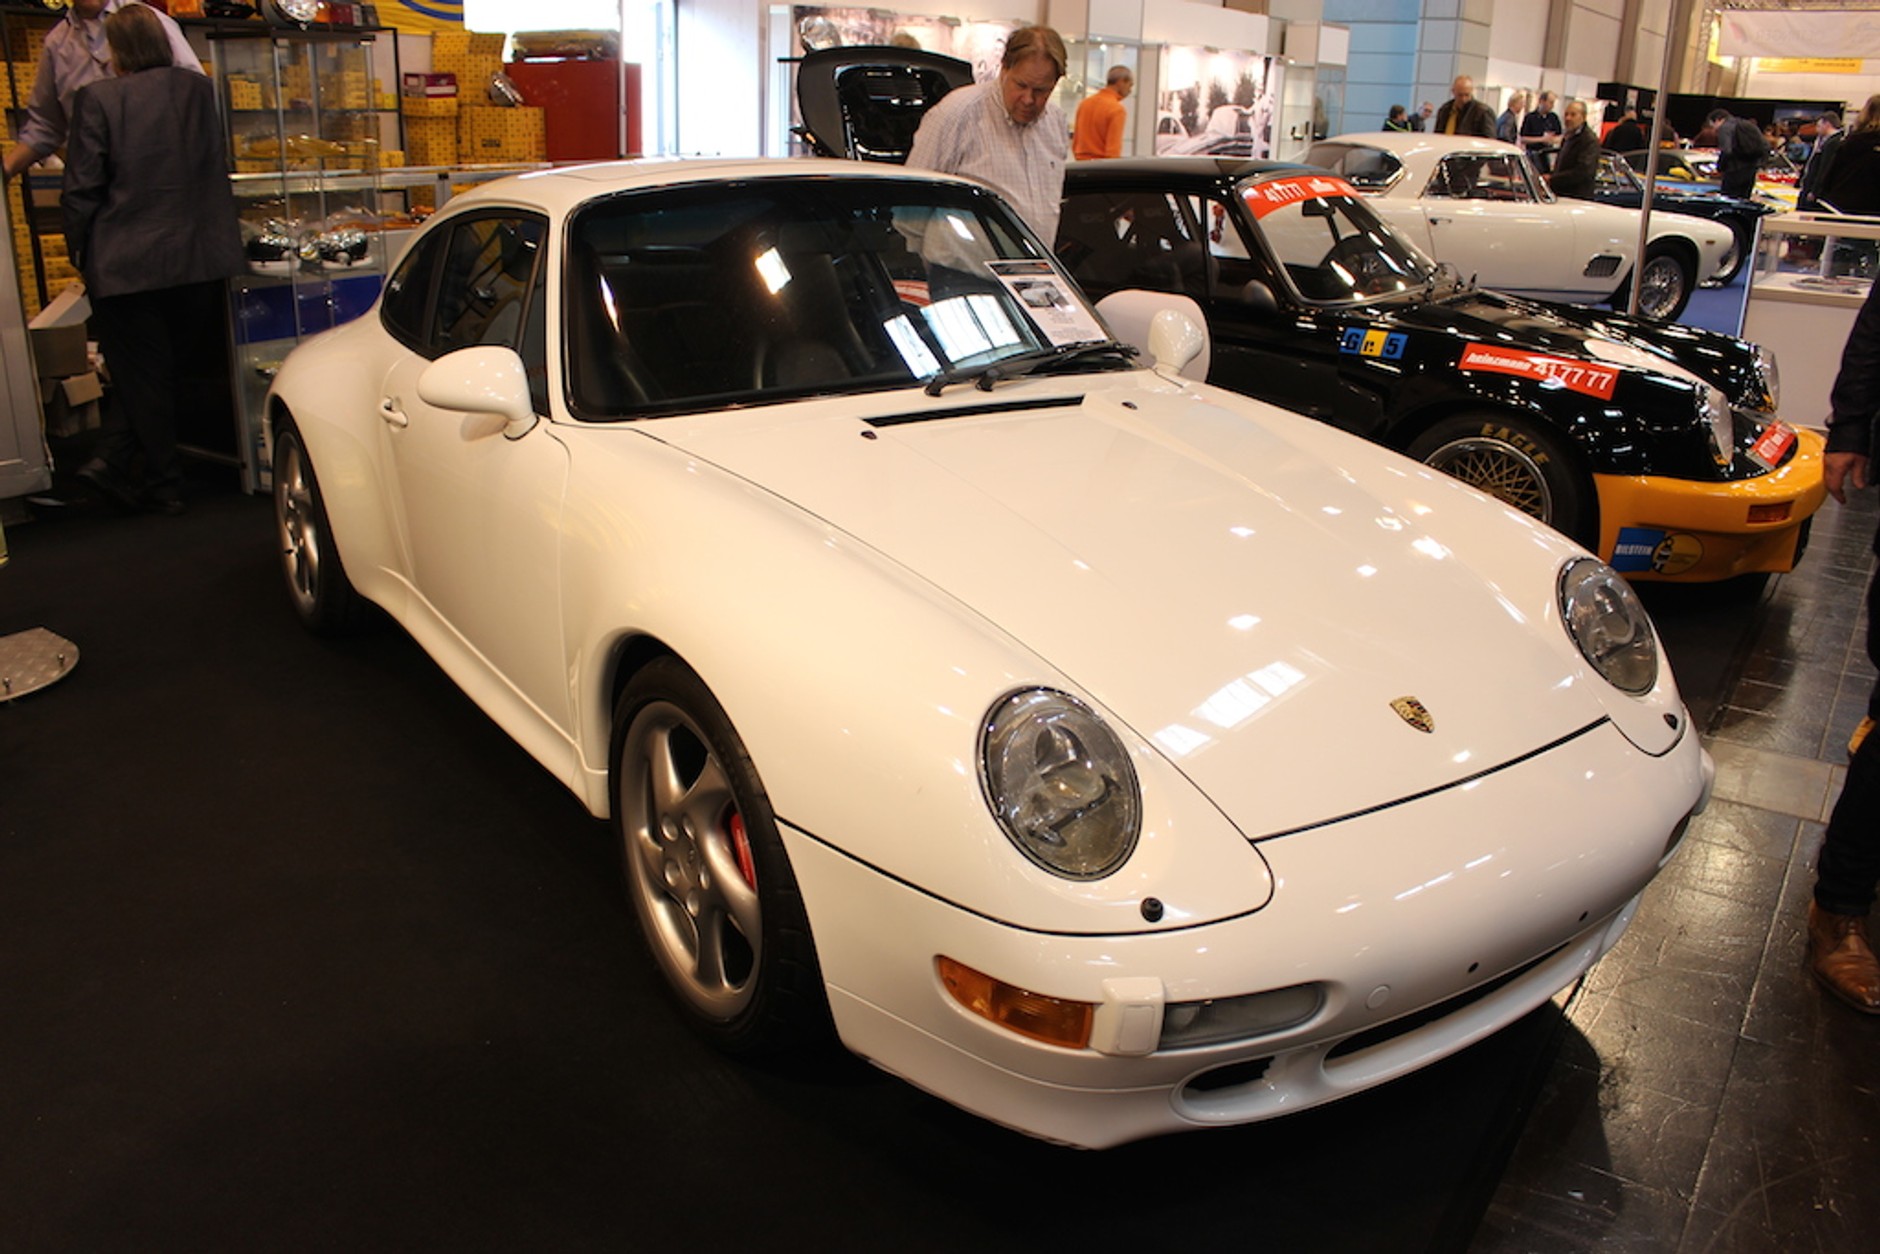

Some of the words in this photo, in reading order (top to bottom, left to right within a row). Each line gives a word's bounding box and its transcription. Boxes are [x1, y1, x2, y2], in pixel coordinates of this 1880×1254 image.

[1386, 337, 1400, 356] 5
[1466, 352, 1532, 371] heinzmann
[1481, 422, 1550, 464] EAGLE
